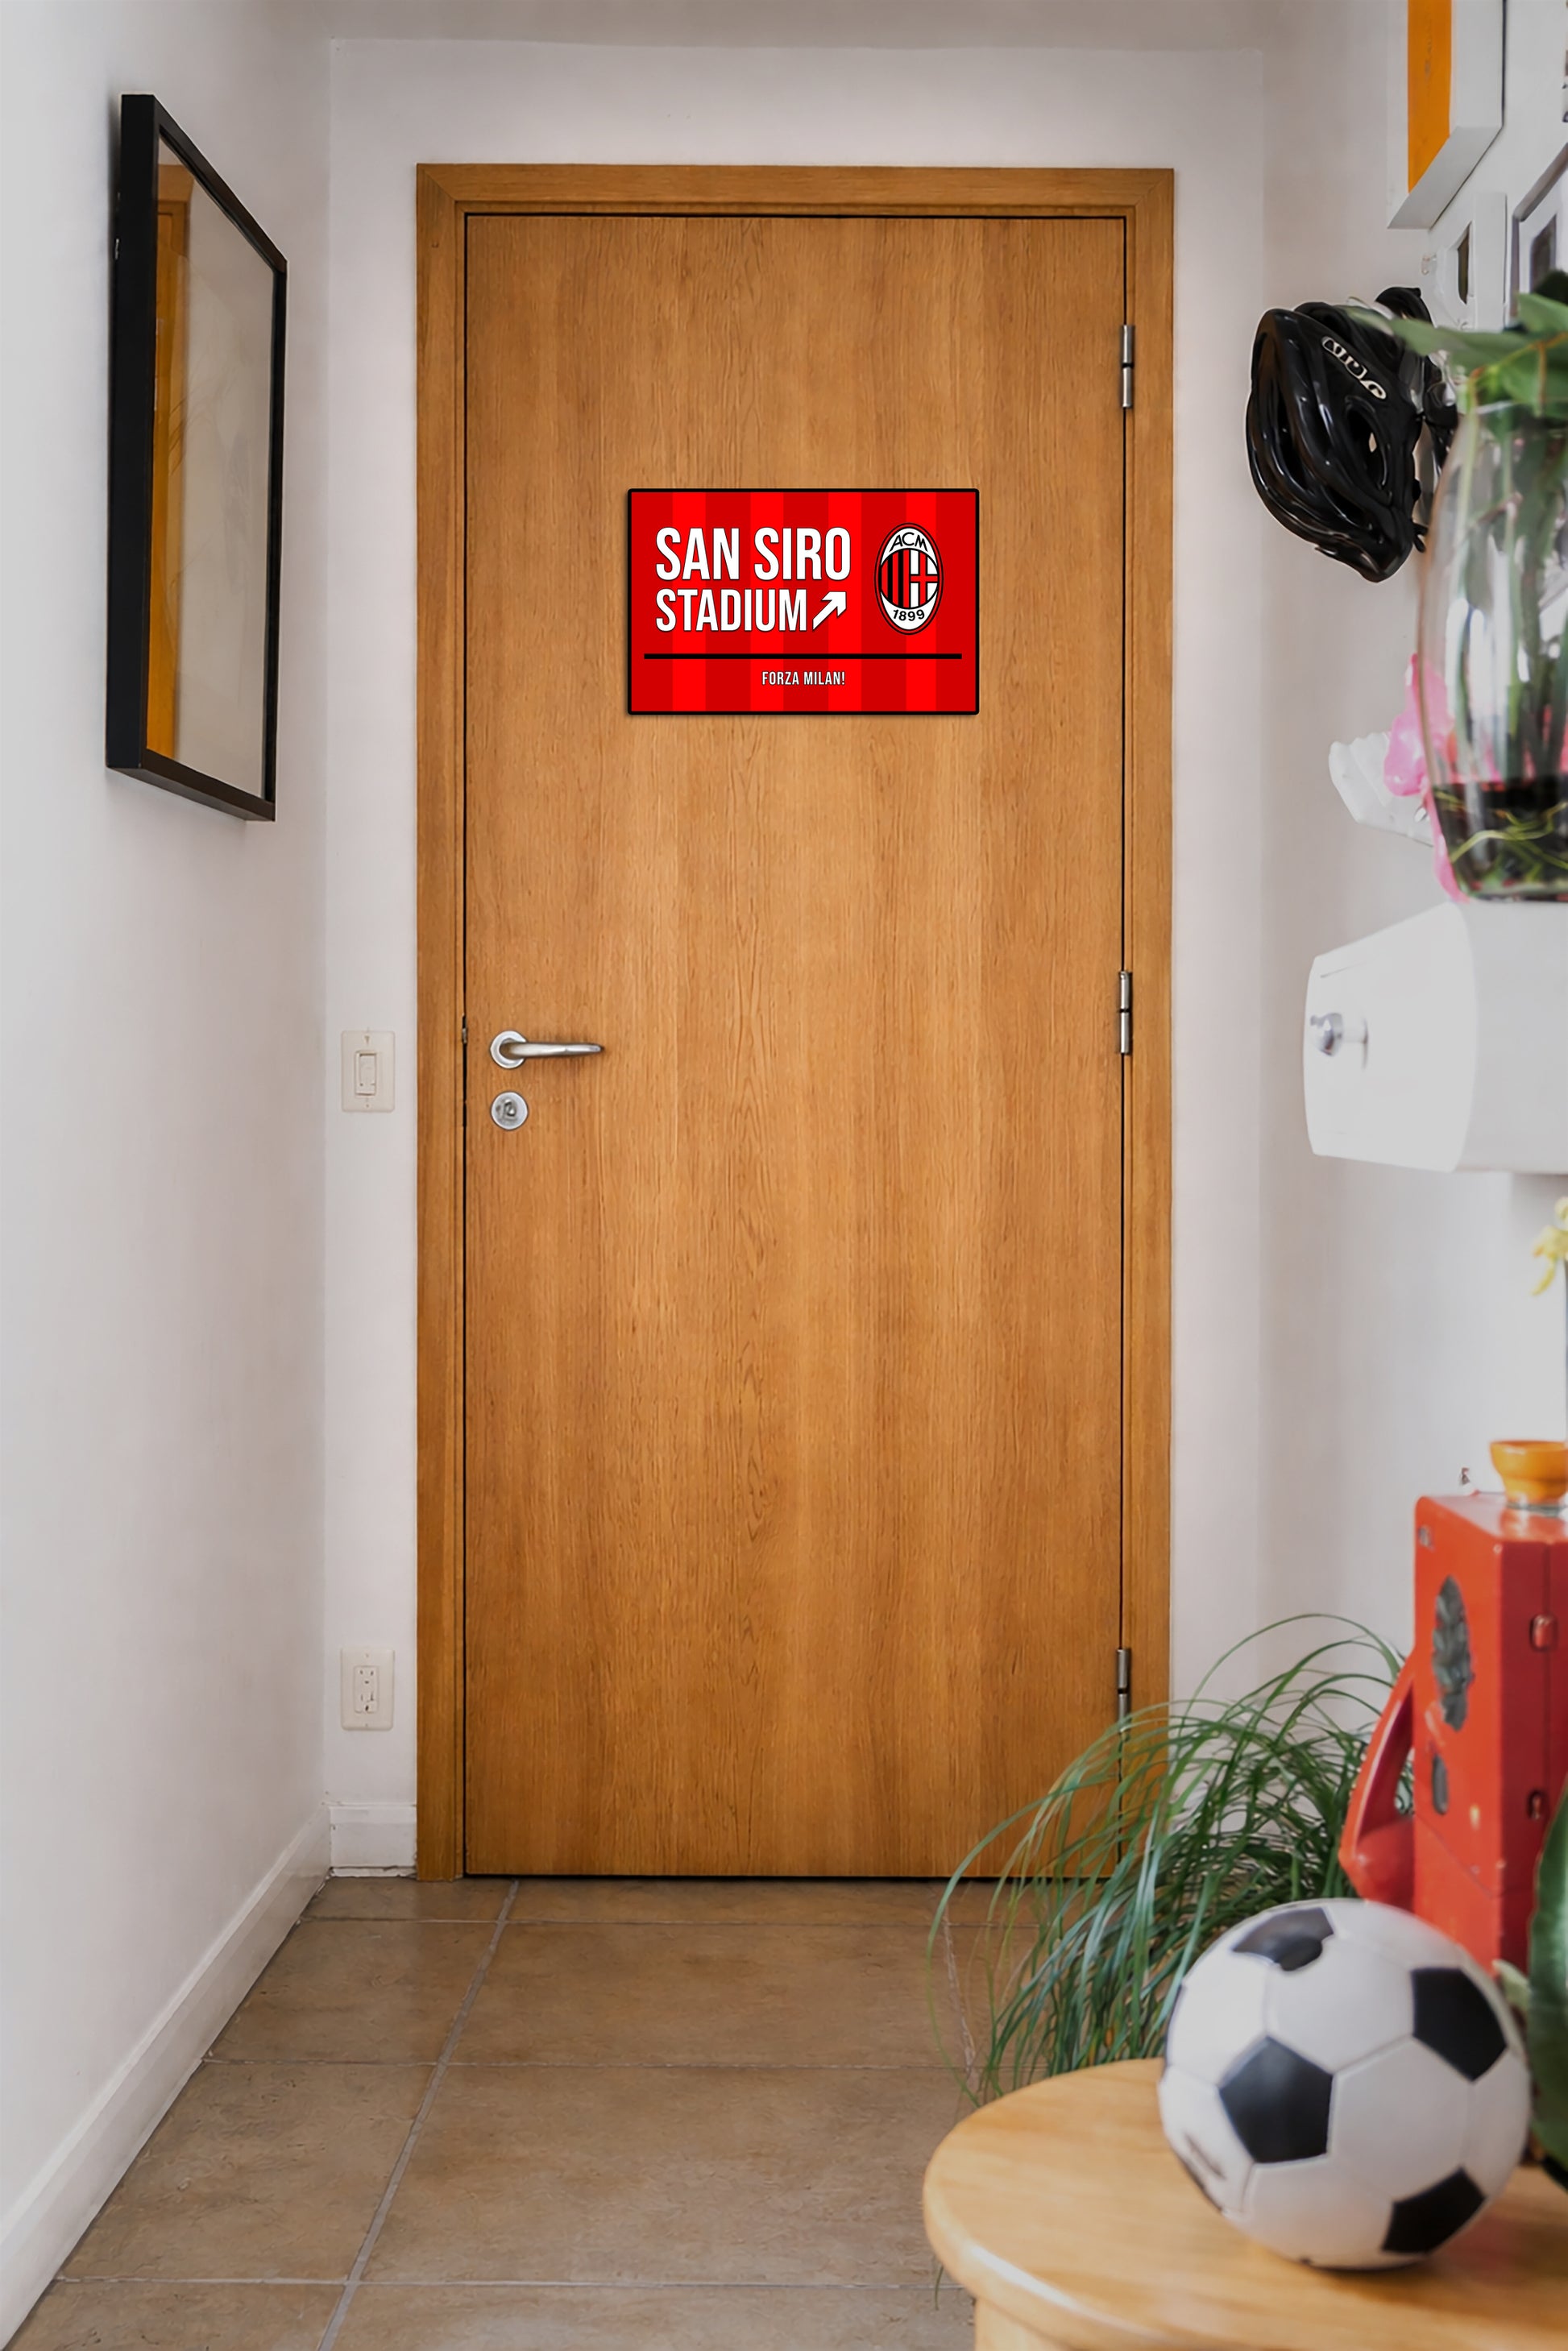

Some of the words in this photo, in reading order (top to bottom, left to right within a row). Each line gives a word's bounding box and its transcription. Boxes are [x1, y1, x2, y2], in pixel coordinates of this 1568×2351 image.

[889, 531, 928, 553] ACM
[655, 527, 740, 581] SAN
[753, 527, 852, 581] SIRO
[655, 588, 807, 632] STADIUM
[893, 608, 925, 622] 1899
[761, 671, 800, 686] FORZA
[803, 671, 846, 686] MILAN!
